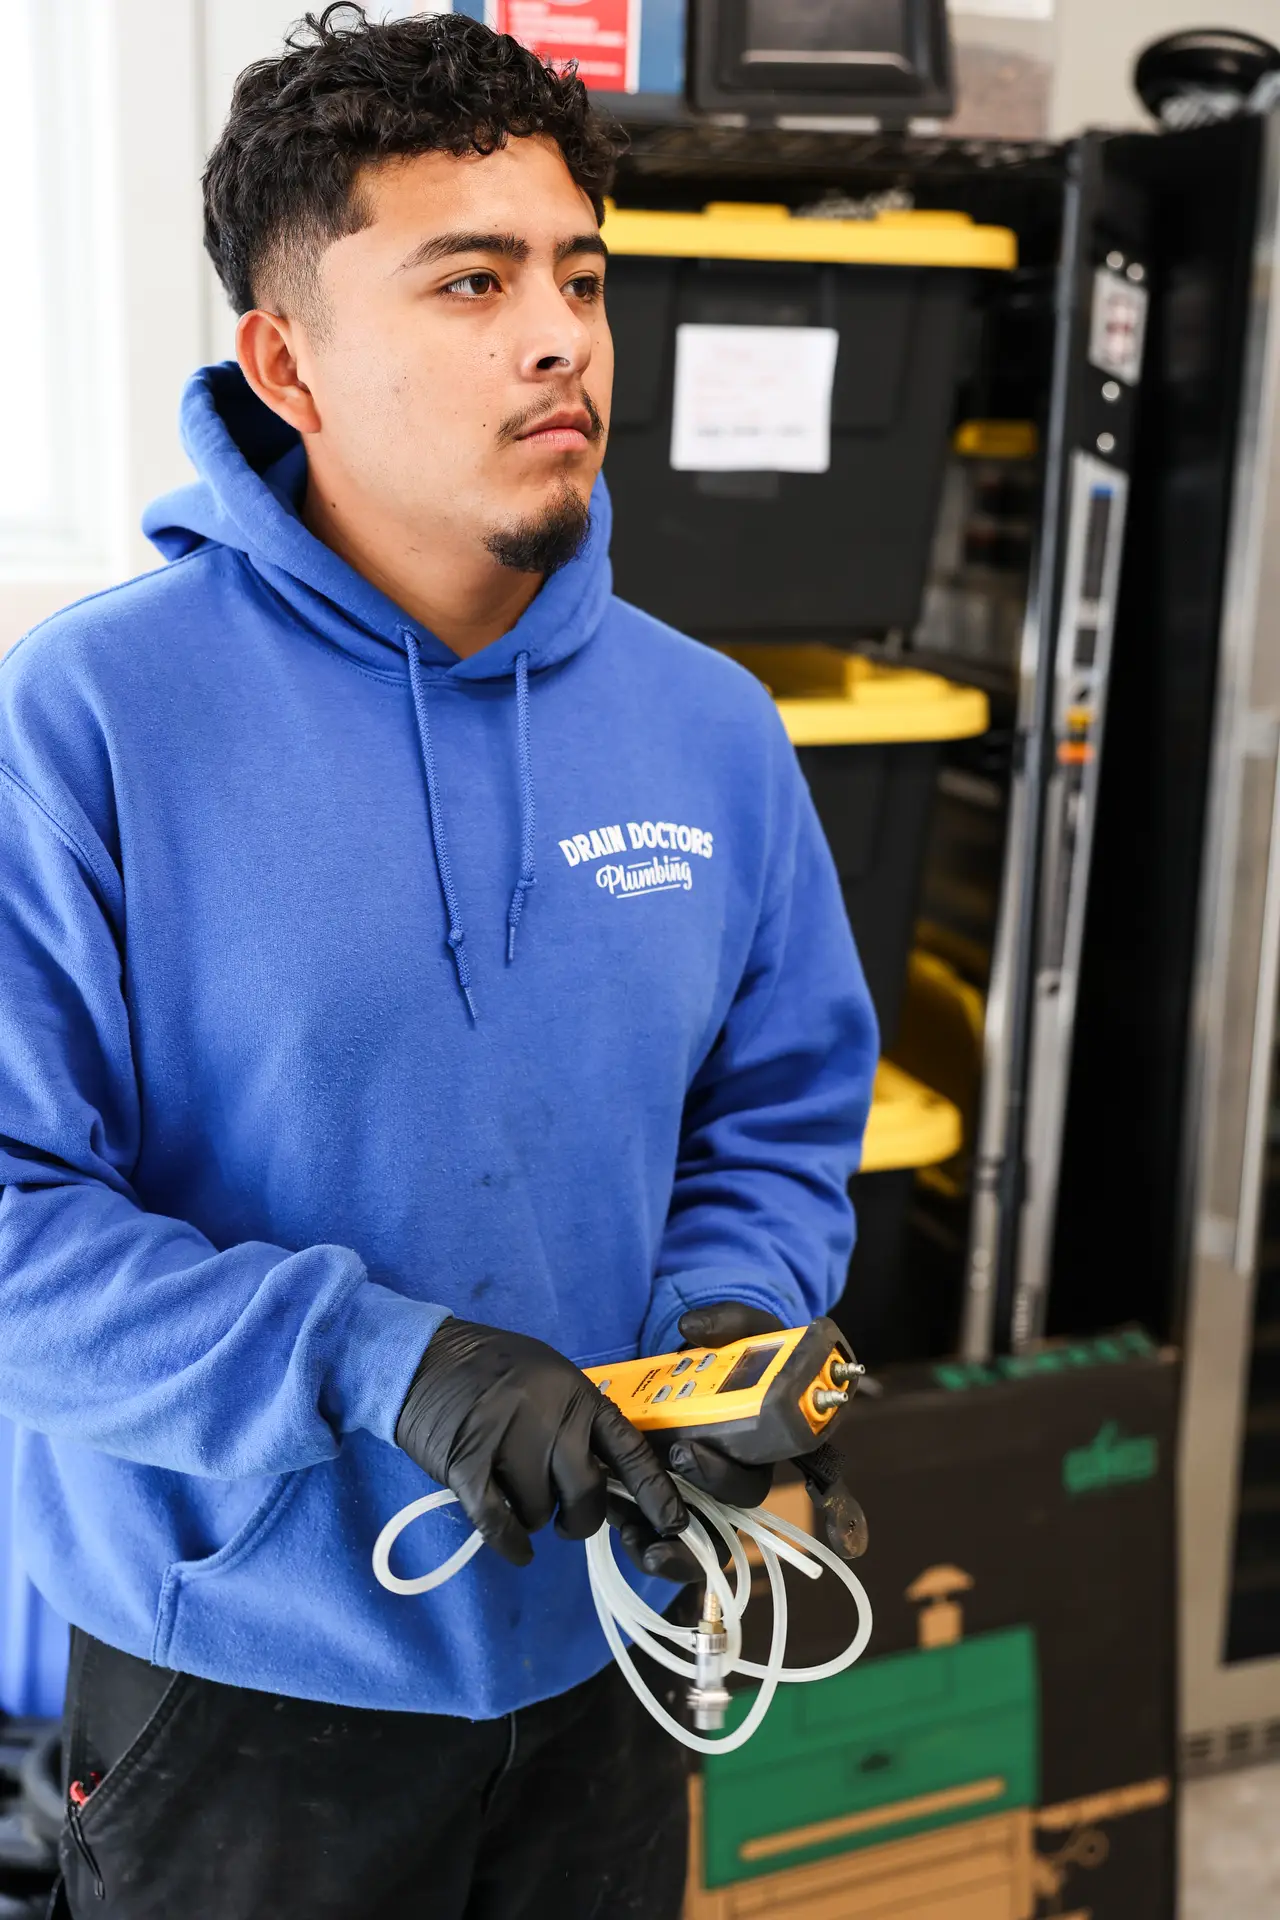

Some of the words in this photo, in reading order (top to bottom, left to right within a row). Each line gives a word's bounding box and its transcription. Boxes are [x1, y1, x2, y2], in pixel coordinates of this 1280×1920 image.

[558, 825, 627, 867] DRAIN
[626, 821, 714, 859] DOCTORS
[595, 855, 693, 895] Plumbing
